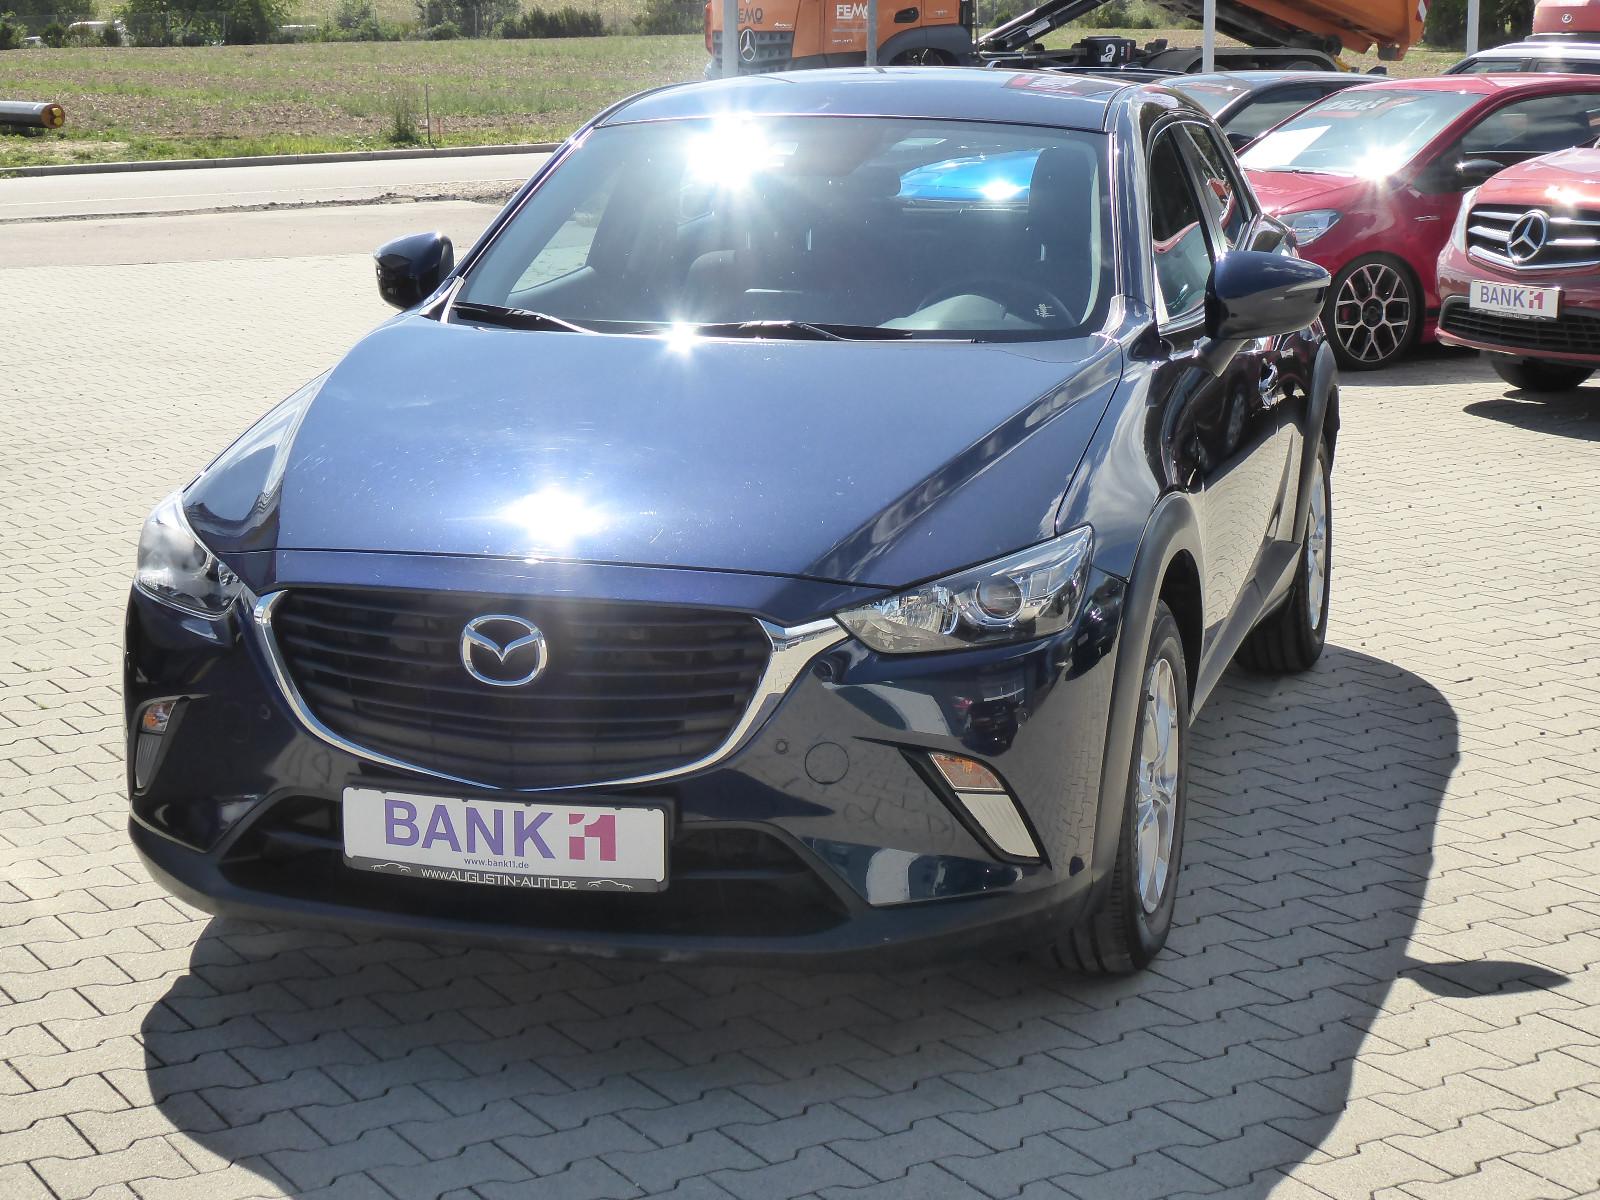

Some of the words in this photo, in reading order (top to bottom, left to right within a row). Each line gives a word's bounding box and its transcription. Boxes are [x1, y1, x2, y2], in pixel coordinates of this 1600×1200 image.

[738, 7, 763, 24] EMO
[1480, 285, 1525, 308] BANK
[384, 798, 556, 860] BANK
[463, 857, 529, 869] www.bank11.de
